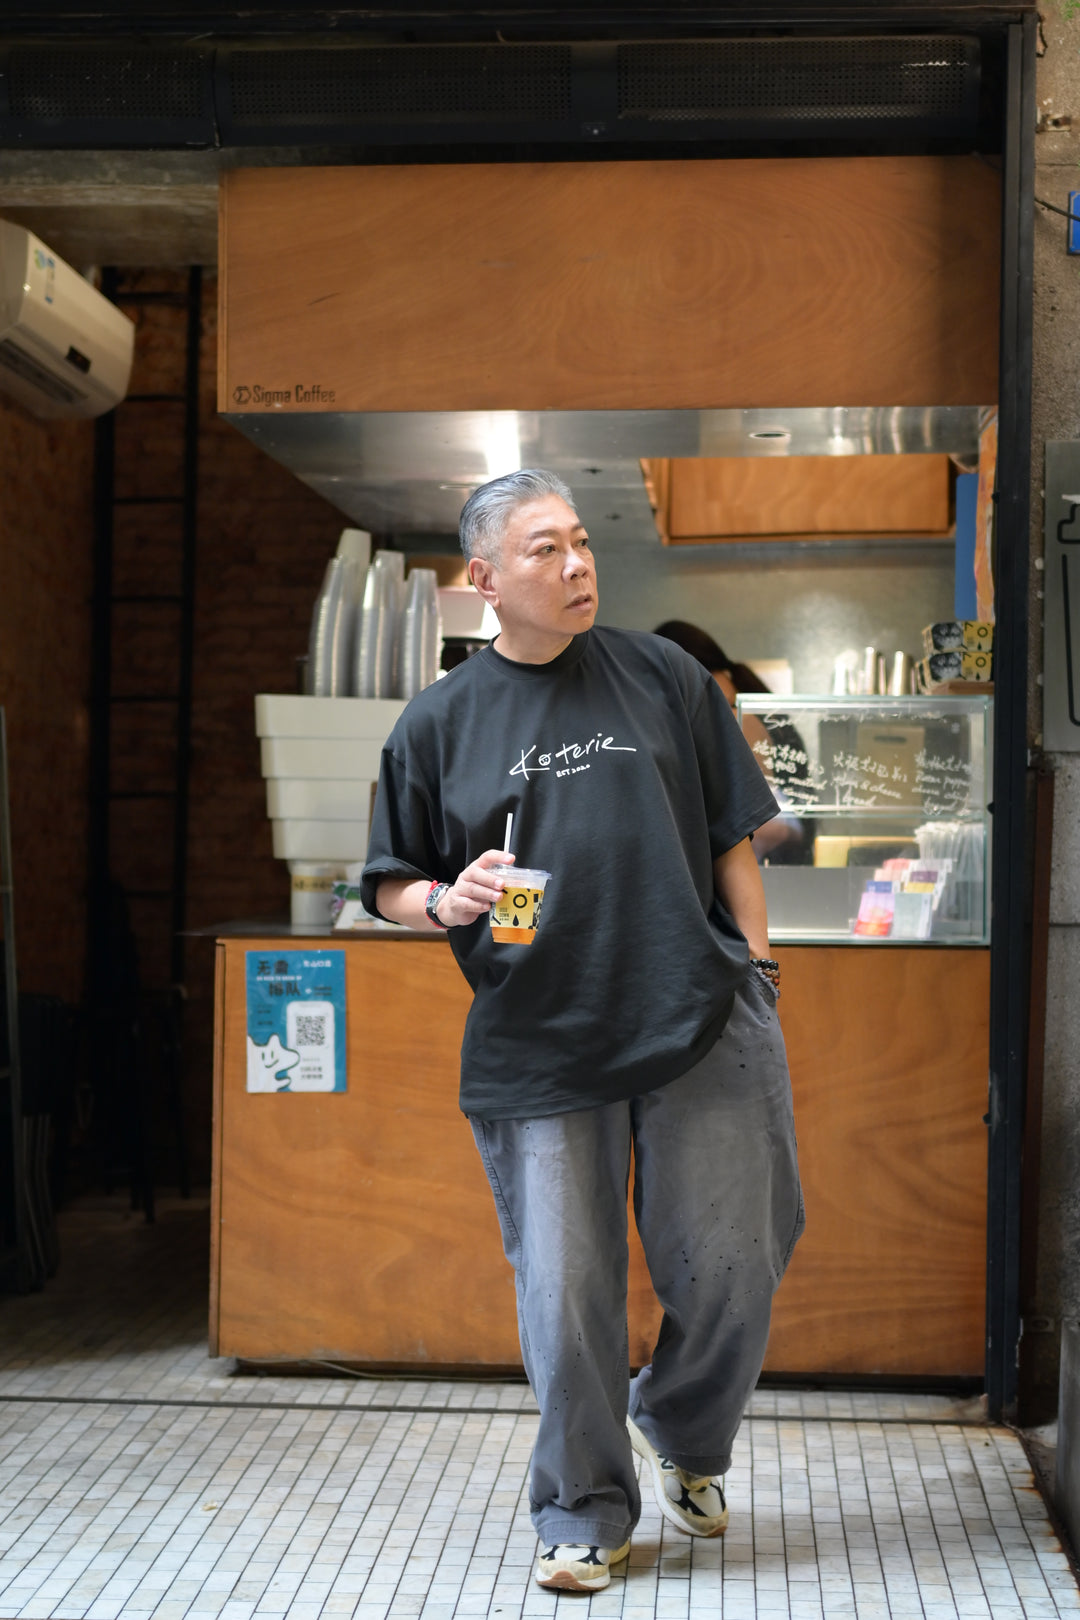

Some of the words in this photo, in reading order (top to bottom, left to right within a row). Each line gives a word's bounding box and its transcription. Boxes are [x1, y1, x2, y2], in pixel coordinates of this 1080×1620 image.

[253, 385, 291, 407] Sigma
[295, 384, 336, 403] Coffee
[509, 733, 637, 781] Koterie
